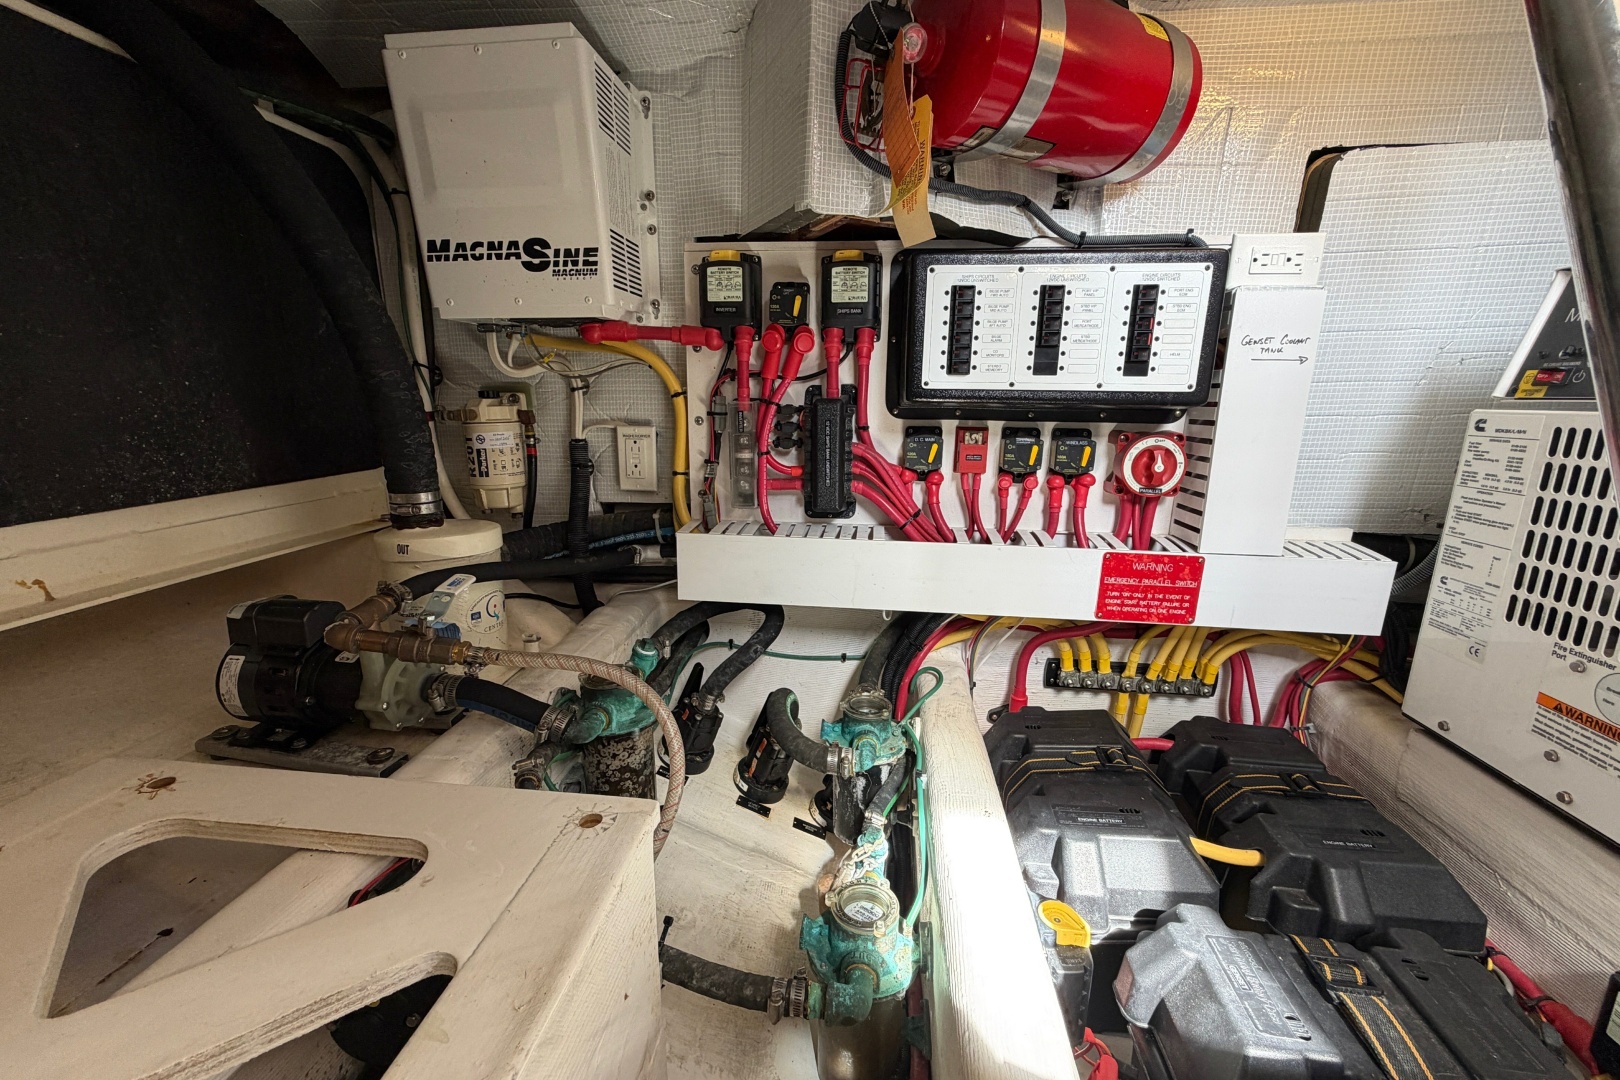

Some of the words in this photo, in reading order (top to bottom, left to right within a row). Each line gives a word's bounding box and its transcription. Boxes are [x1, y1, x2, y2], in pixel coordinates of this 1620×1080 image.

[552, 268, 598, 277] MAGNUM
[1241, 334, 1275, 346] GENSET
[1260, 347, 1283, 355] TANK
[396, 543, 410, 556] OUT
[1132, 562, 1174, 572] WARNING
[1142, 578, 1173, 586] PARALLEL
[1175, 580, 1198, 588] SWITCH
[1551, 650, 1567, 662] Port
[1554, 642, 1568, 653] Fire
[1569, 648, 1618, 671] Extinguisher
